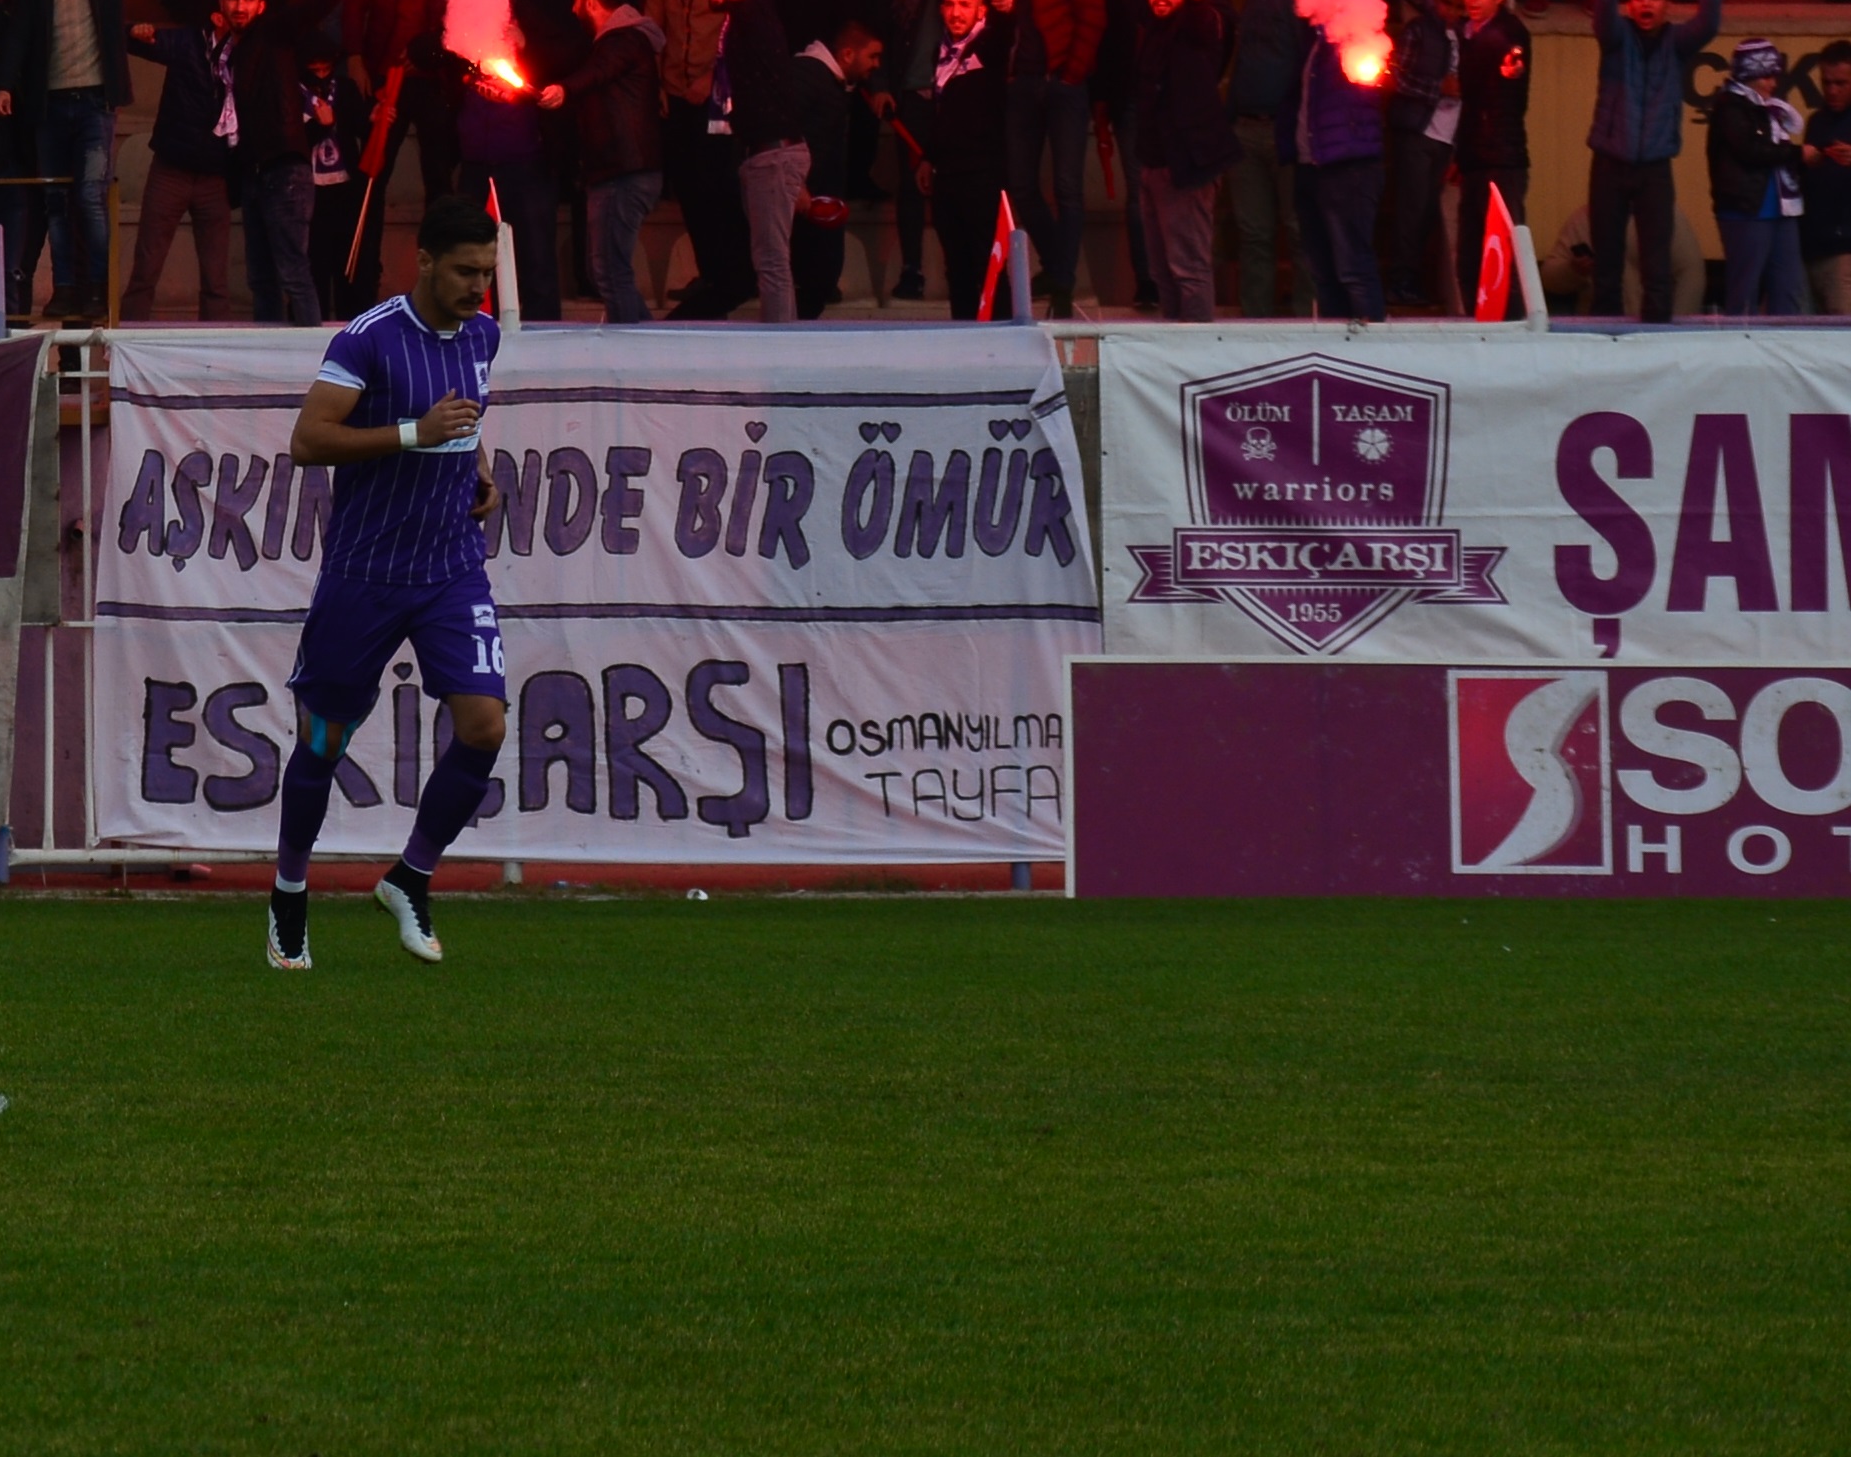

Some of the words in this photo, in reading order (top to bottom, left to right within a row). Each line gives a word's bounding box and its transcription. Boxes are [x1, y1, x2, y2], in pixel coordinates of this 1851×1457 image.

[1225, 402, 1292, 422] ÖLÜM
[1331, 405, 1415, 426] YAŞAM
[674, 421, 815, 570] BİR
[841, 418, 1076, 568] ÖMÜR
[1233, 476, 1395, 502] warriors
[1287, 603, 1343, 623] 1955
[470, 633, 506, 677] 16
[865, 764, 1062, 823] TAYFA
